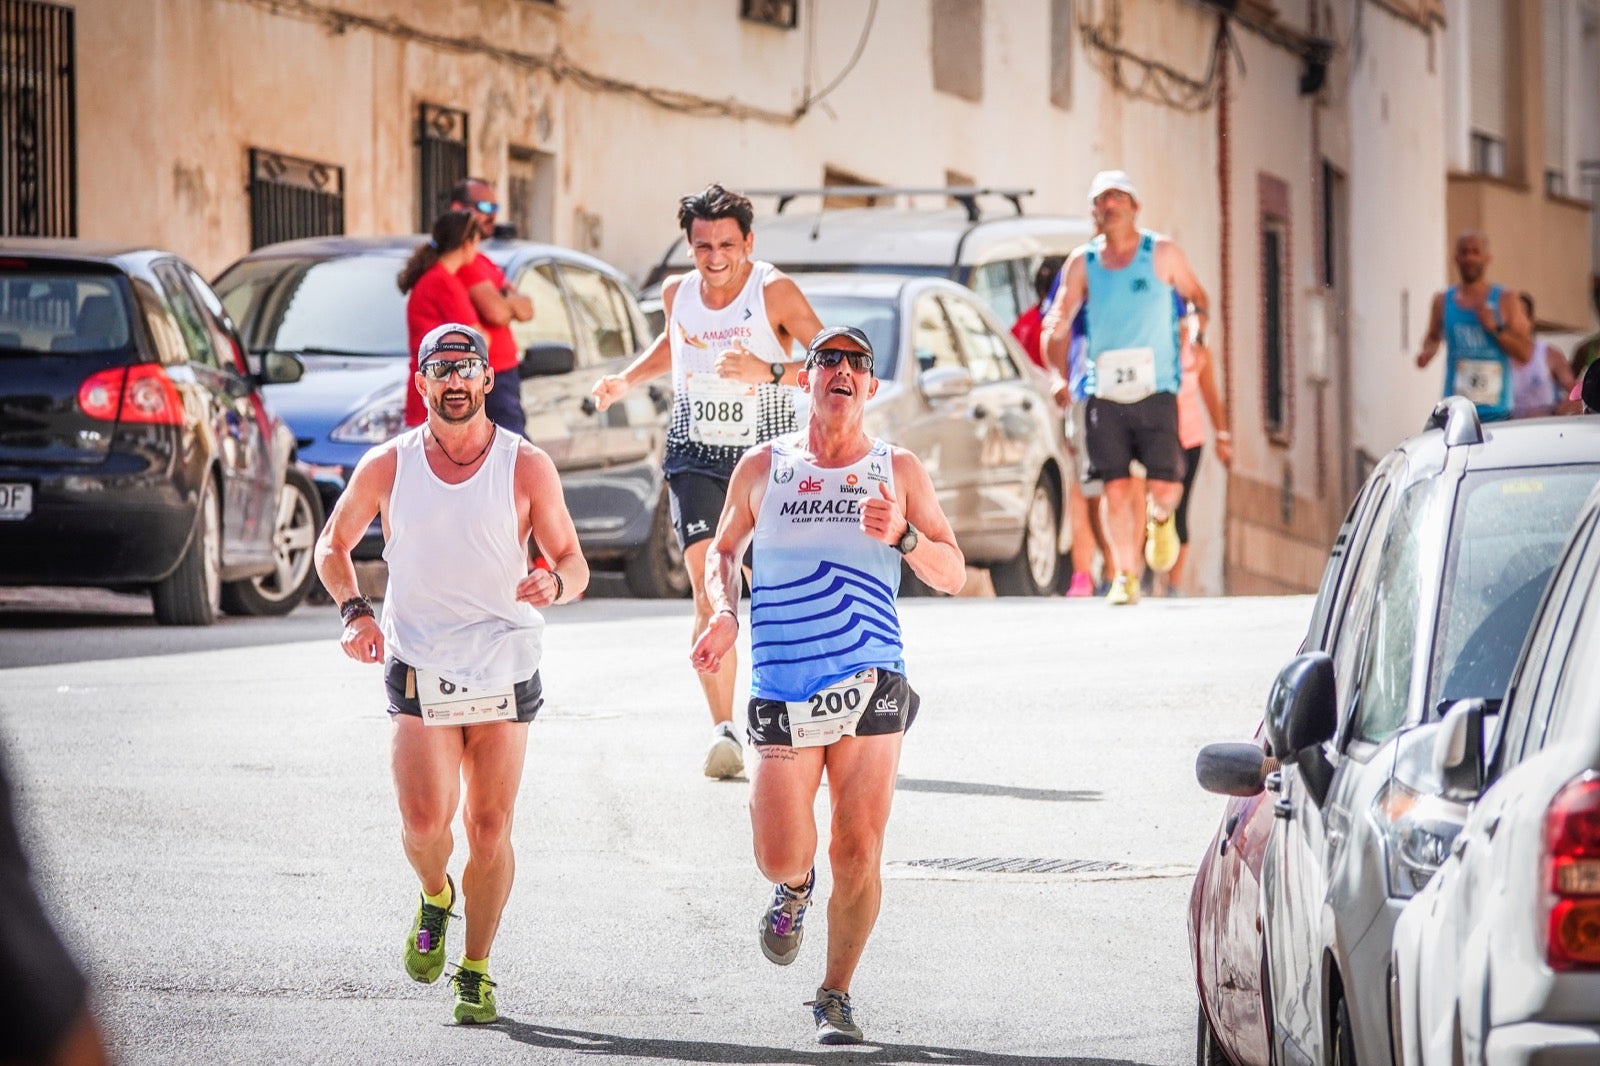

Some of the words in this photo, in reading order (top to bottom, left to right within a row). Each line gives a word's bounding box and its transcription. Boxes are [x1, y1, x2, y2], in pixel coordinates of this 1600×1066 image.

[702, 327, 752, 340] AMADORES
[693, 401, 744, 422] 3088
[807, 687, 861, 718] 200
